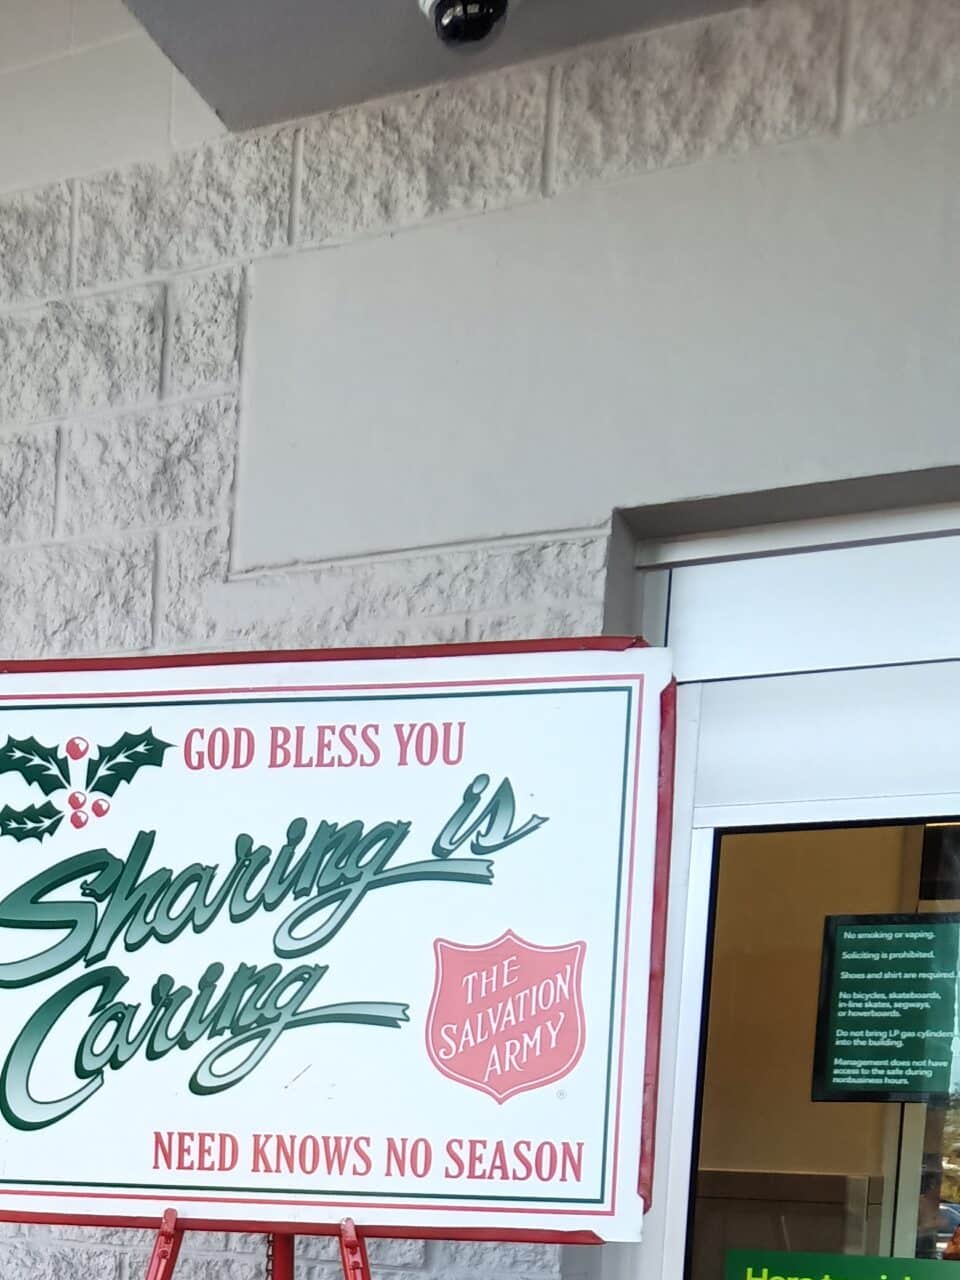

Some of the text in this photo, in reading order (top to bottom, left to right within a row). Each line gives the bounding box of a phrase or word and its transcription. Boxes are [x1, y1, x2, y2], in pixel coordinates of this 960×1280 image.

[183, 721, 466, 770] GOD BLESS YOU
[431, 773, 550, 859] is
[843, 931, 856, 939] No
[857, 931, 893, 940] smoking
[905, 931, 936, 940] vaping.
[842, 951, 935, 960] Soliciting is prohibited.
[462, 955, 521, 1005] THE
[840, 971, 865, 979] Shoes
[866, 971, 882, 979] and
[883, 971, 902, 979] shirt
[838, 991, 852, 999] No
[439, 964, 571, 1060] SALVATION
[836, 1029, 848, 1037] Do
[865, 1029, 887, 1039] bring
[889, 1029, 899, 1037] LP
[901, 1030, 915, 1039] gas
[835, 1038, 852, 1046] into
[853, 1038, 867, 1046] the
[483, 1012, 565, 1083] ARMY
[833, 1058, 889, 1067] Management
[928, 1059, 948, 1067] have
[905, 1068, 933, 1078] during
[152, 1131, 585, 1182] NEED KNOWS NO SEASON
